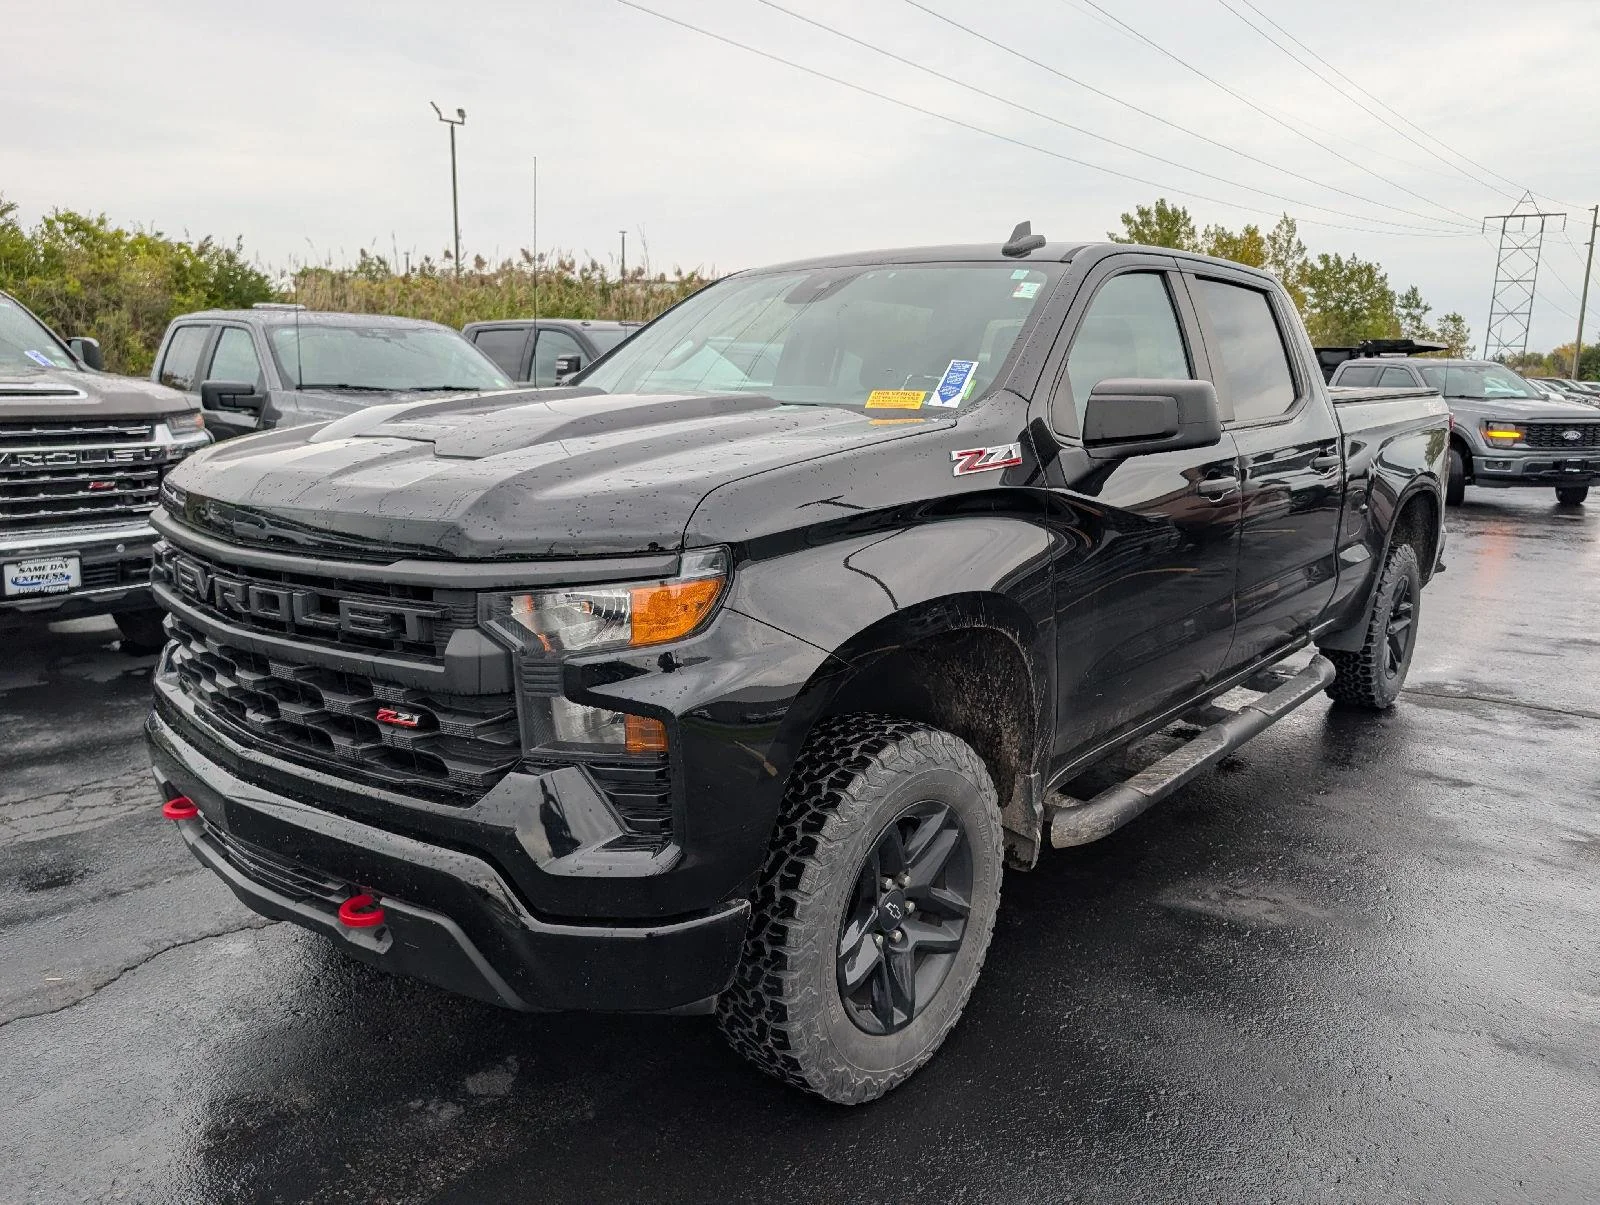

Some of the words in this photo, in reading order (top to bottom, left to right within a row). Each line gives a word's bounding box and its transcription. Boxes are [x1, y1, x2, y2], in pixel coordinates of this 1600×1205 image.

[949, 442, 1022, 476] Z71
[19, 564, 47, 574] SAME
[50, 563, 70, 571] DAY
[376, 707, 420, 726] Z71
